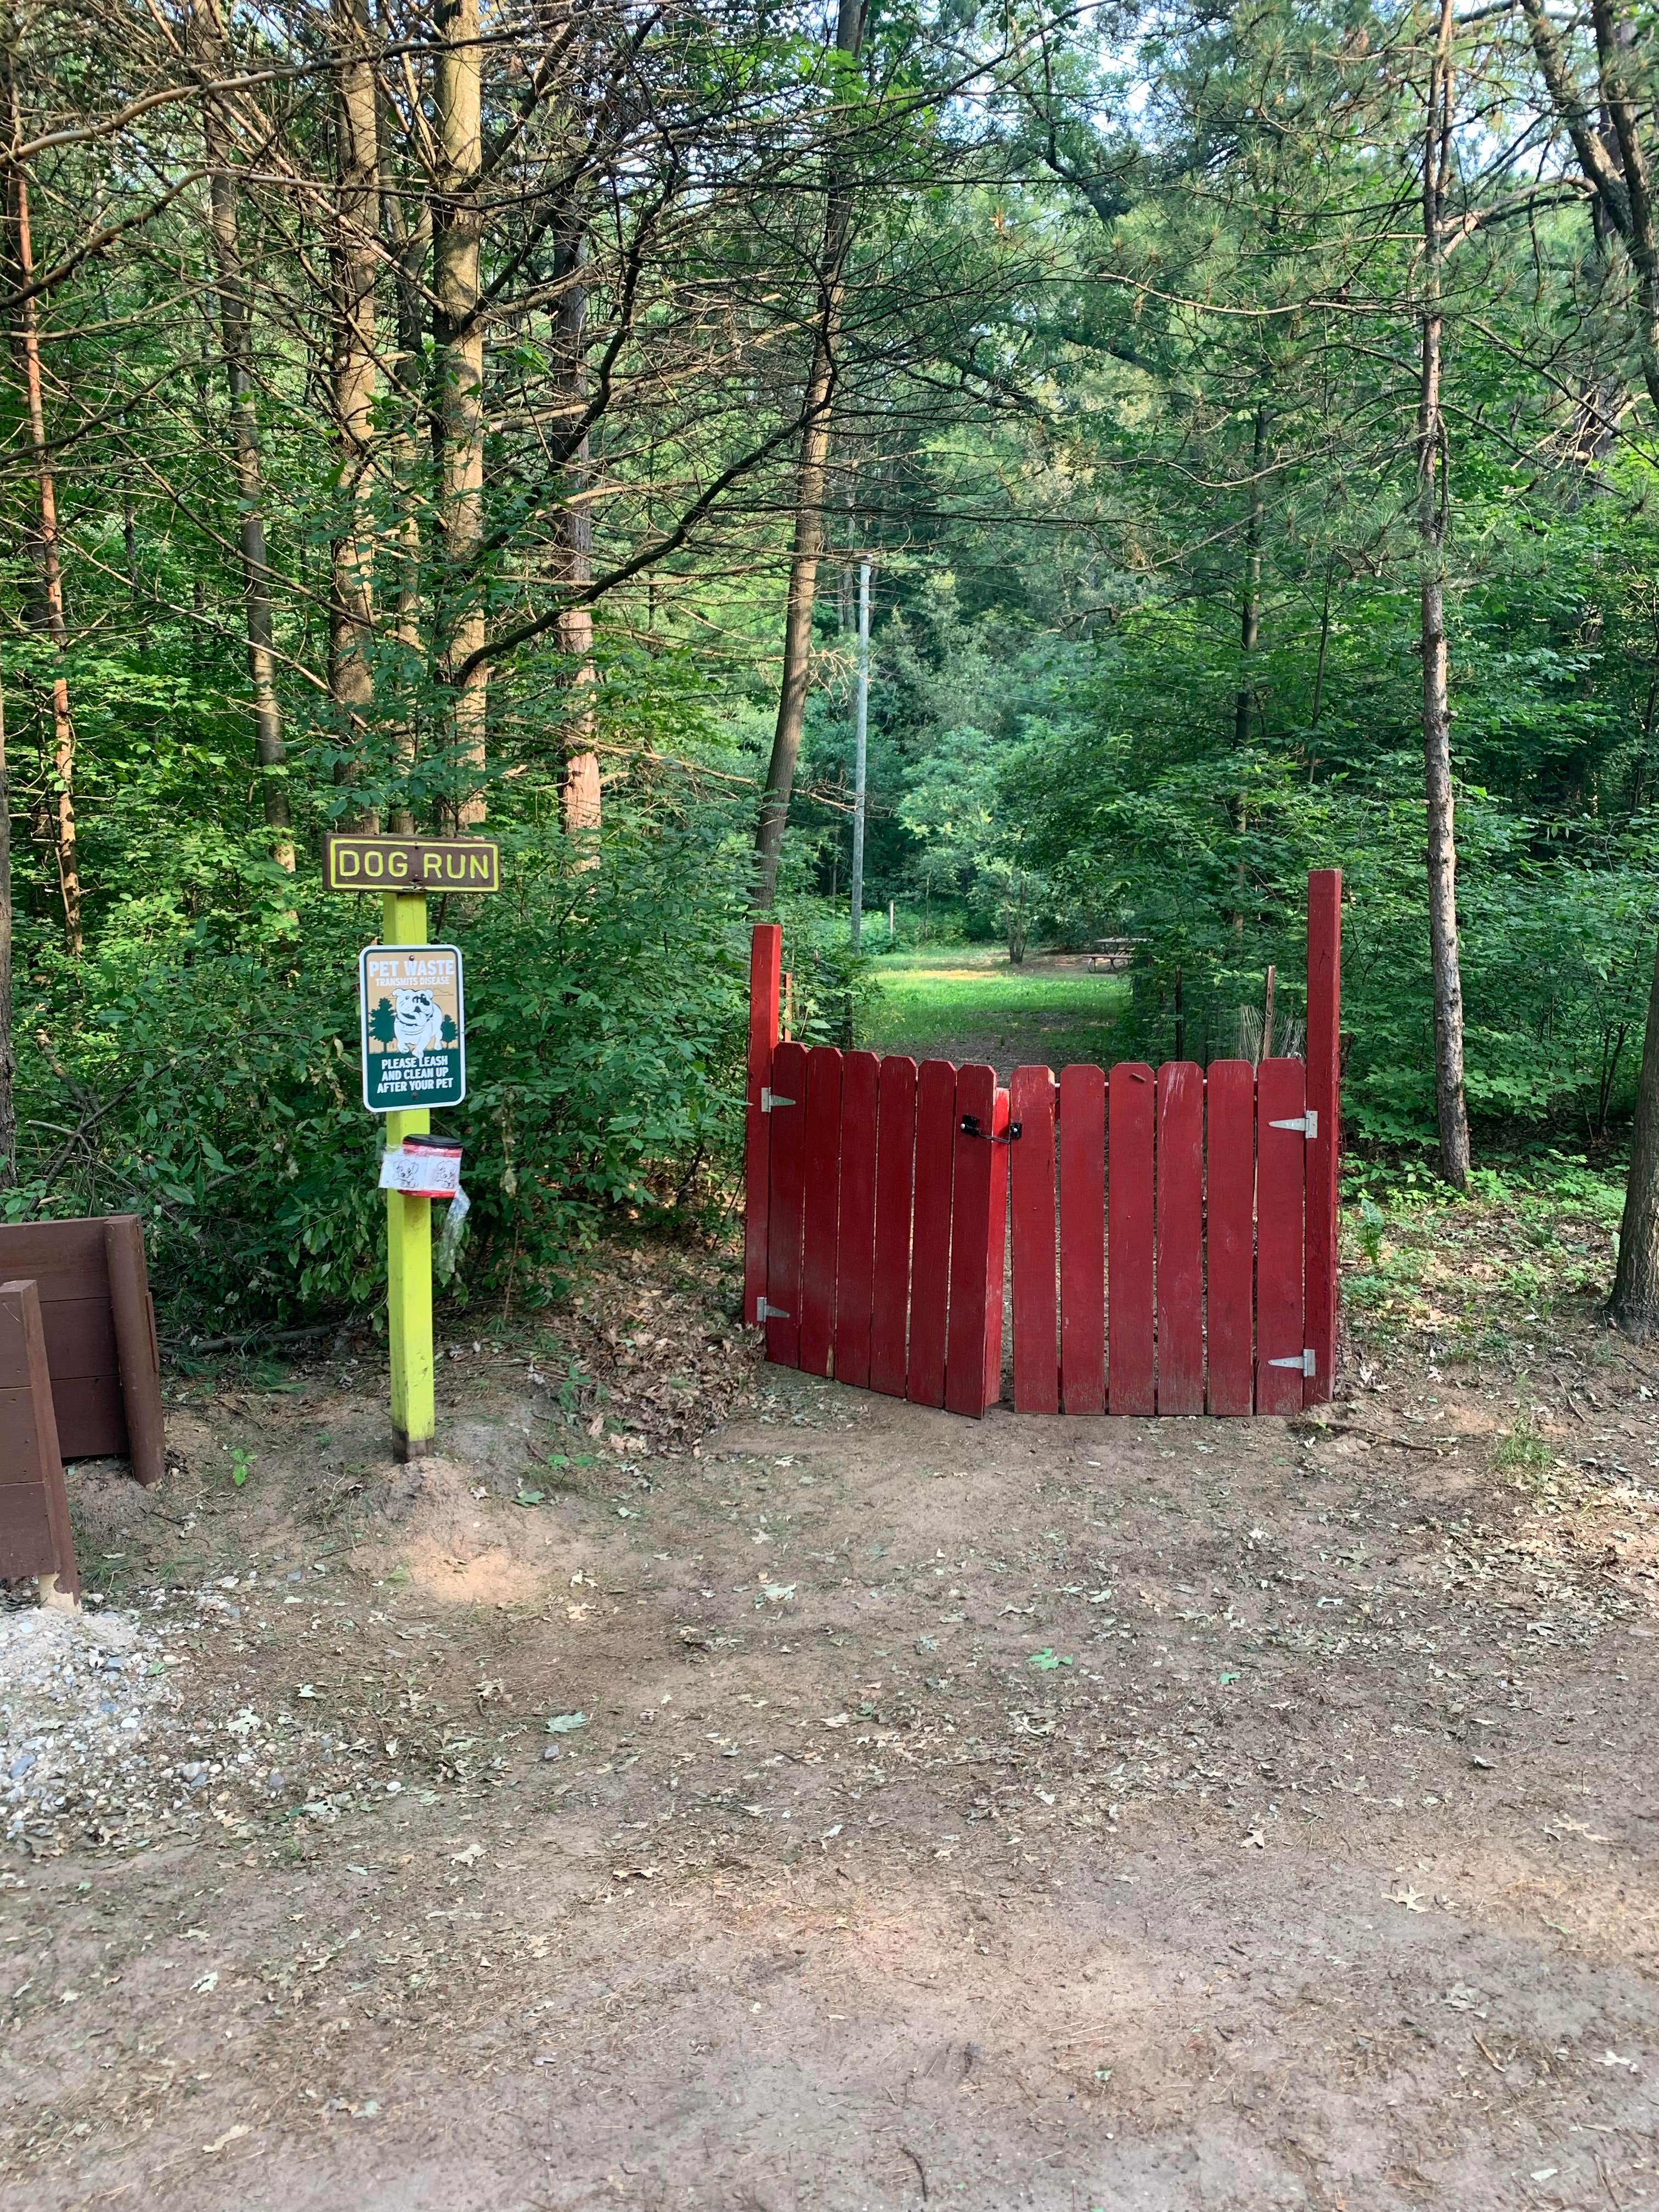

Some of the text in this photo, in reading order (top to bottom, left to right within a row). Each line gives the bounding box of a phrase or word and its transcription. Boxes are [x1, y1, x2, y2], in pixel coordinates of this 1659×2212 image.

[339, 850, 489, 879] DOG RUN
[369, 960, 455, 977] PET WASTE
[375, 976, 449, 986] TRANSMITS DISEASE
[381, 1055, 448, 1069] PLEASE LEASH
[382, 1066, 449, 1081] AND CLEAN UP
[377, 1077, 454, 1093] AFTER YOUR PET
